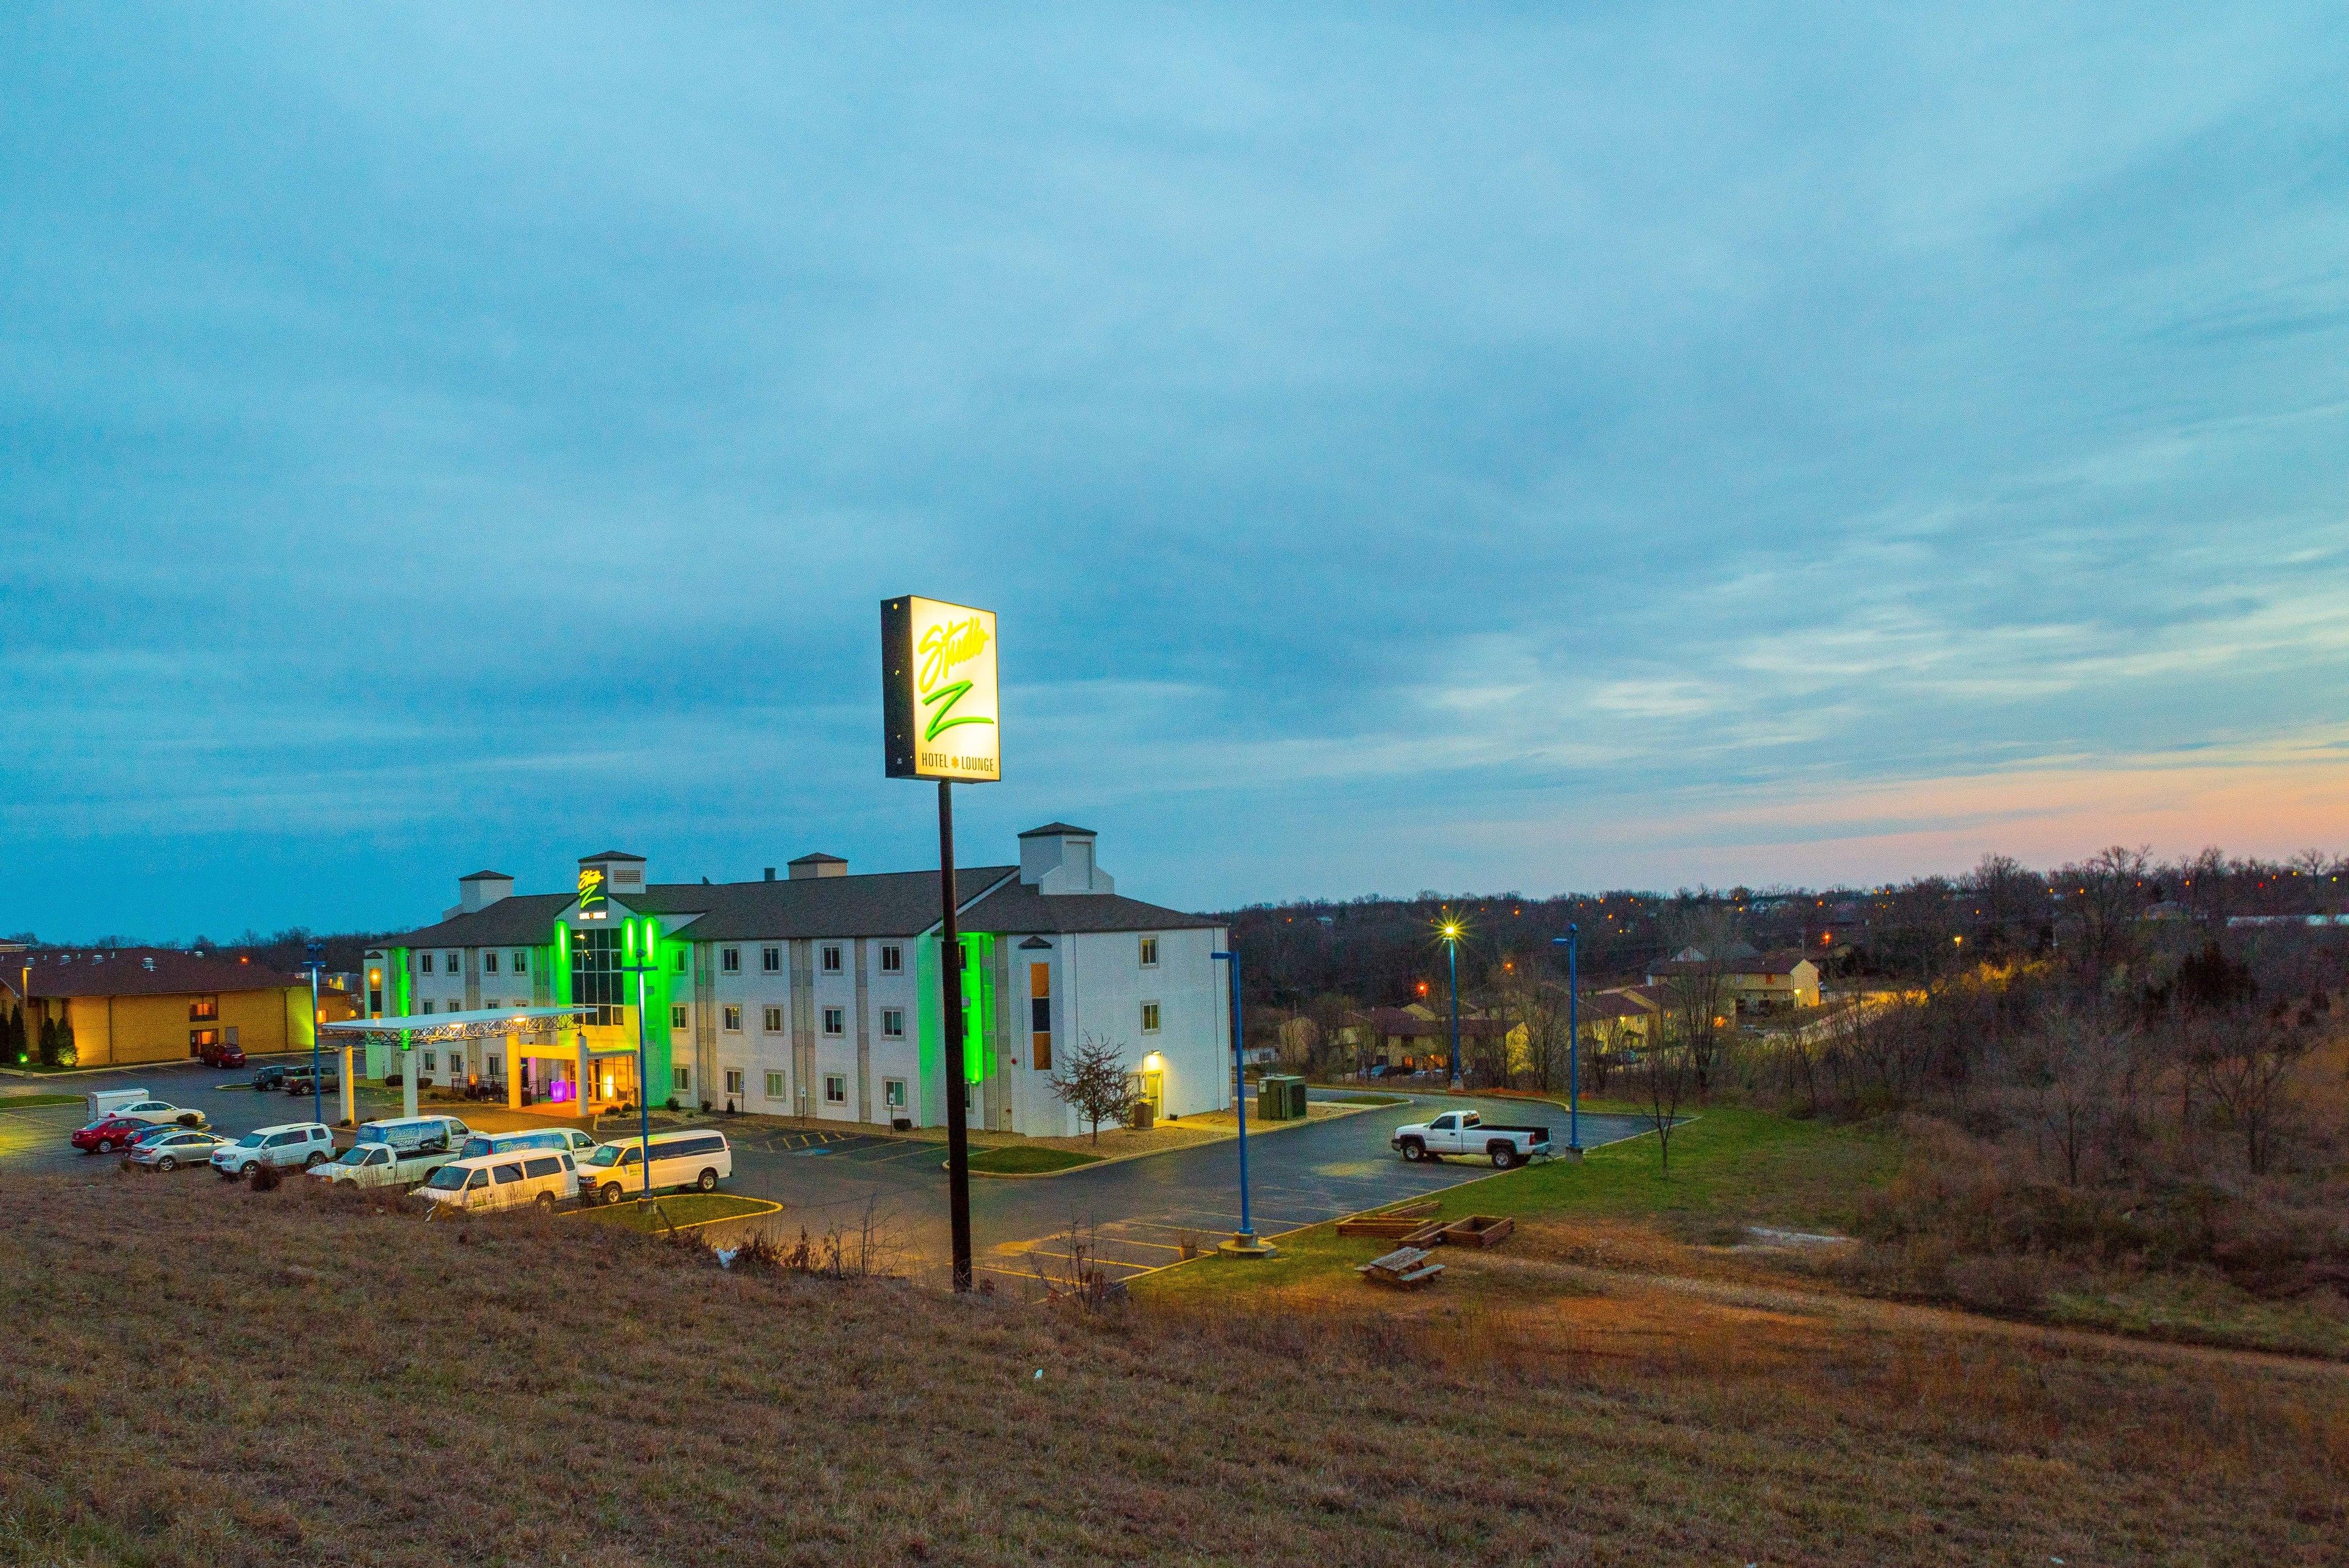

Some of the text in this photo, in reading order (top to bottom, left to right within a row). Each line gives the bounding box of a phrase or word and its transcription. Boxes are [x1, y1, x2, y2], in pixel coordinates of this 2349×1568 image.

[918, 616, 990, 693] Studio
[922, 680, 994, 742] Z
[921, 752, 994, 772] HOTEL LOUNGE
[579, 884, 605, 908] Z
